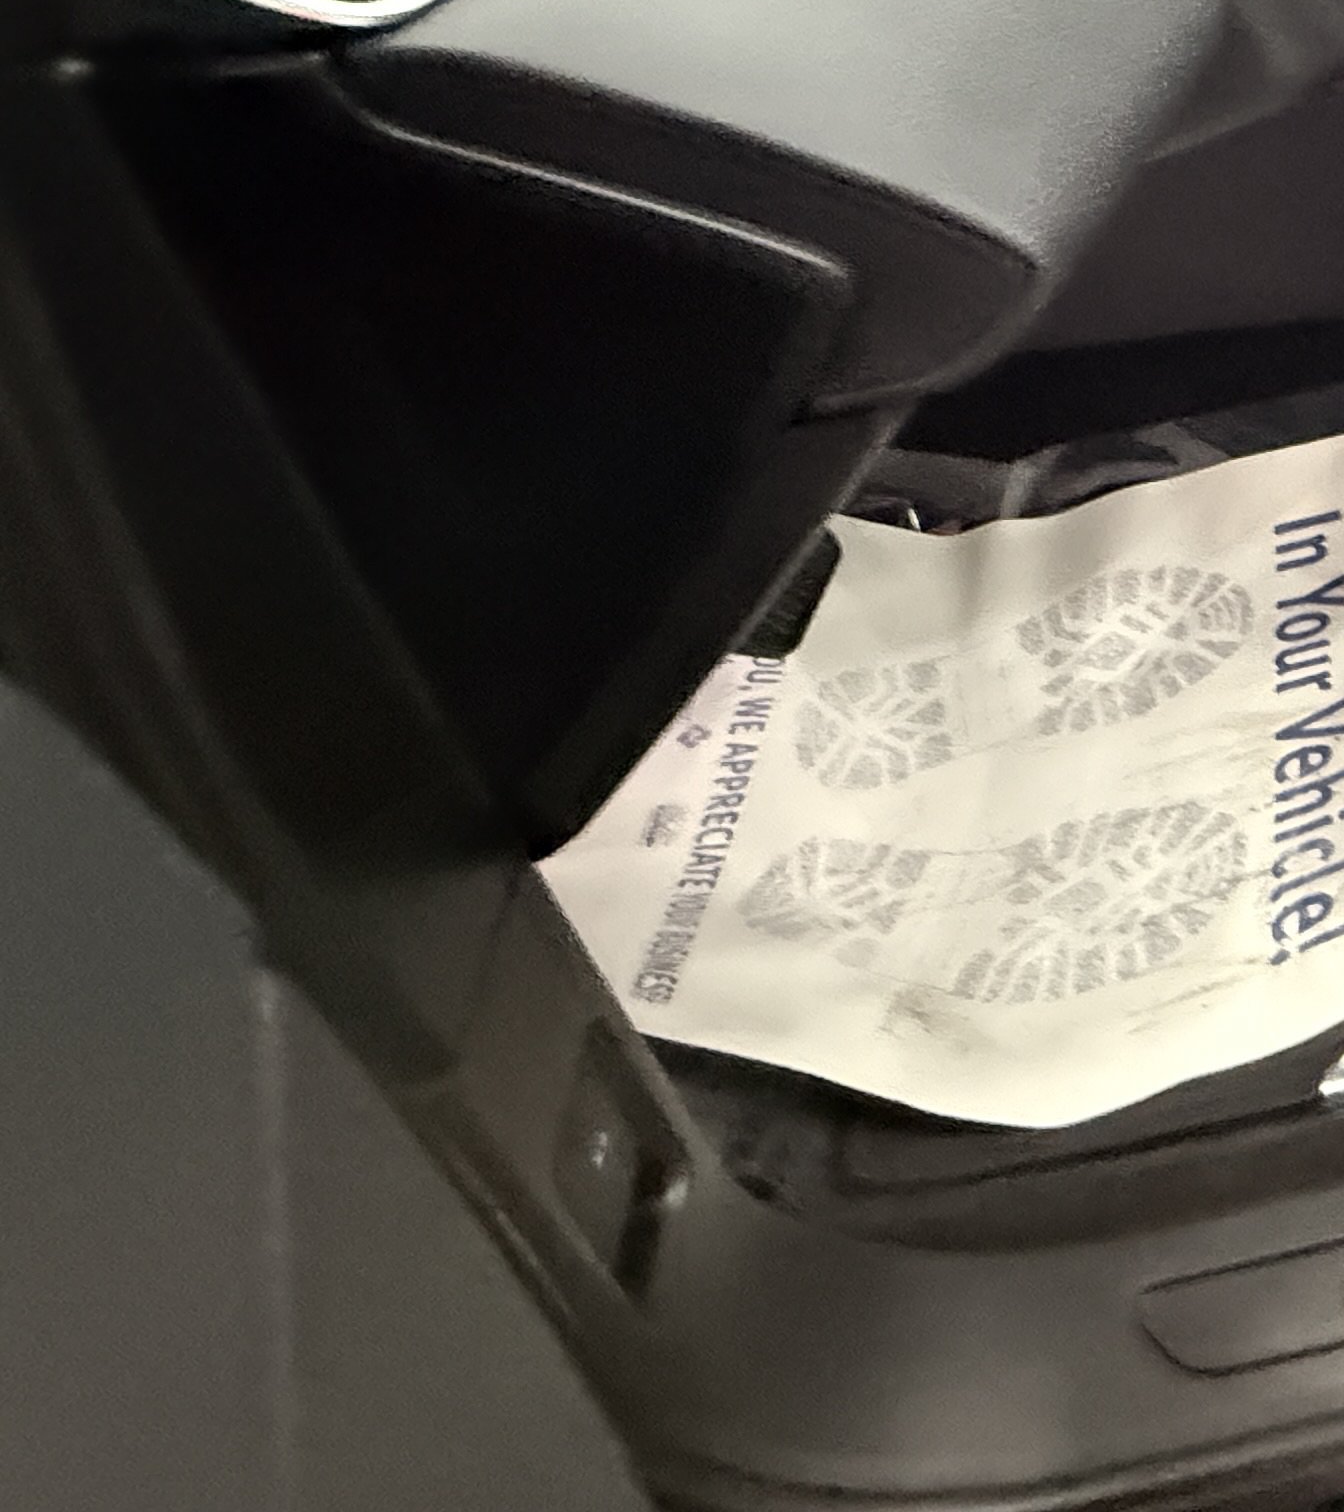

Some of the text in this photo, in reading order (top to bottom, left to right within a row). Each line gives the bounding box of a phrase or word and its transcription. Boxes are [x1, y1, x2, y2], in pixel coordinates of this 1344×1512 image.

[1274, 509, 1343, 572] In
[727, 696, 776, 736] WE
[676, 742, 760, 890] APPRECIATE
